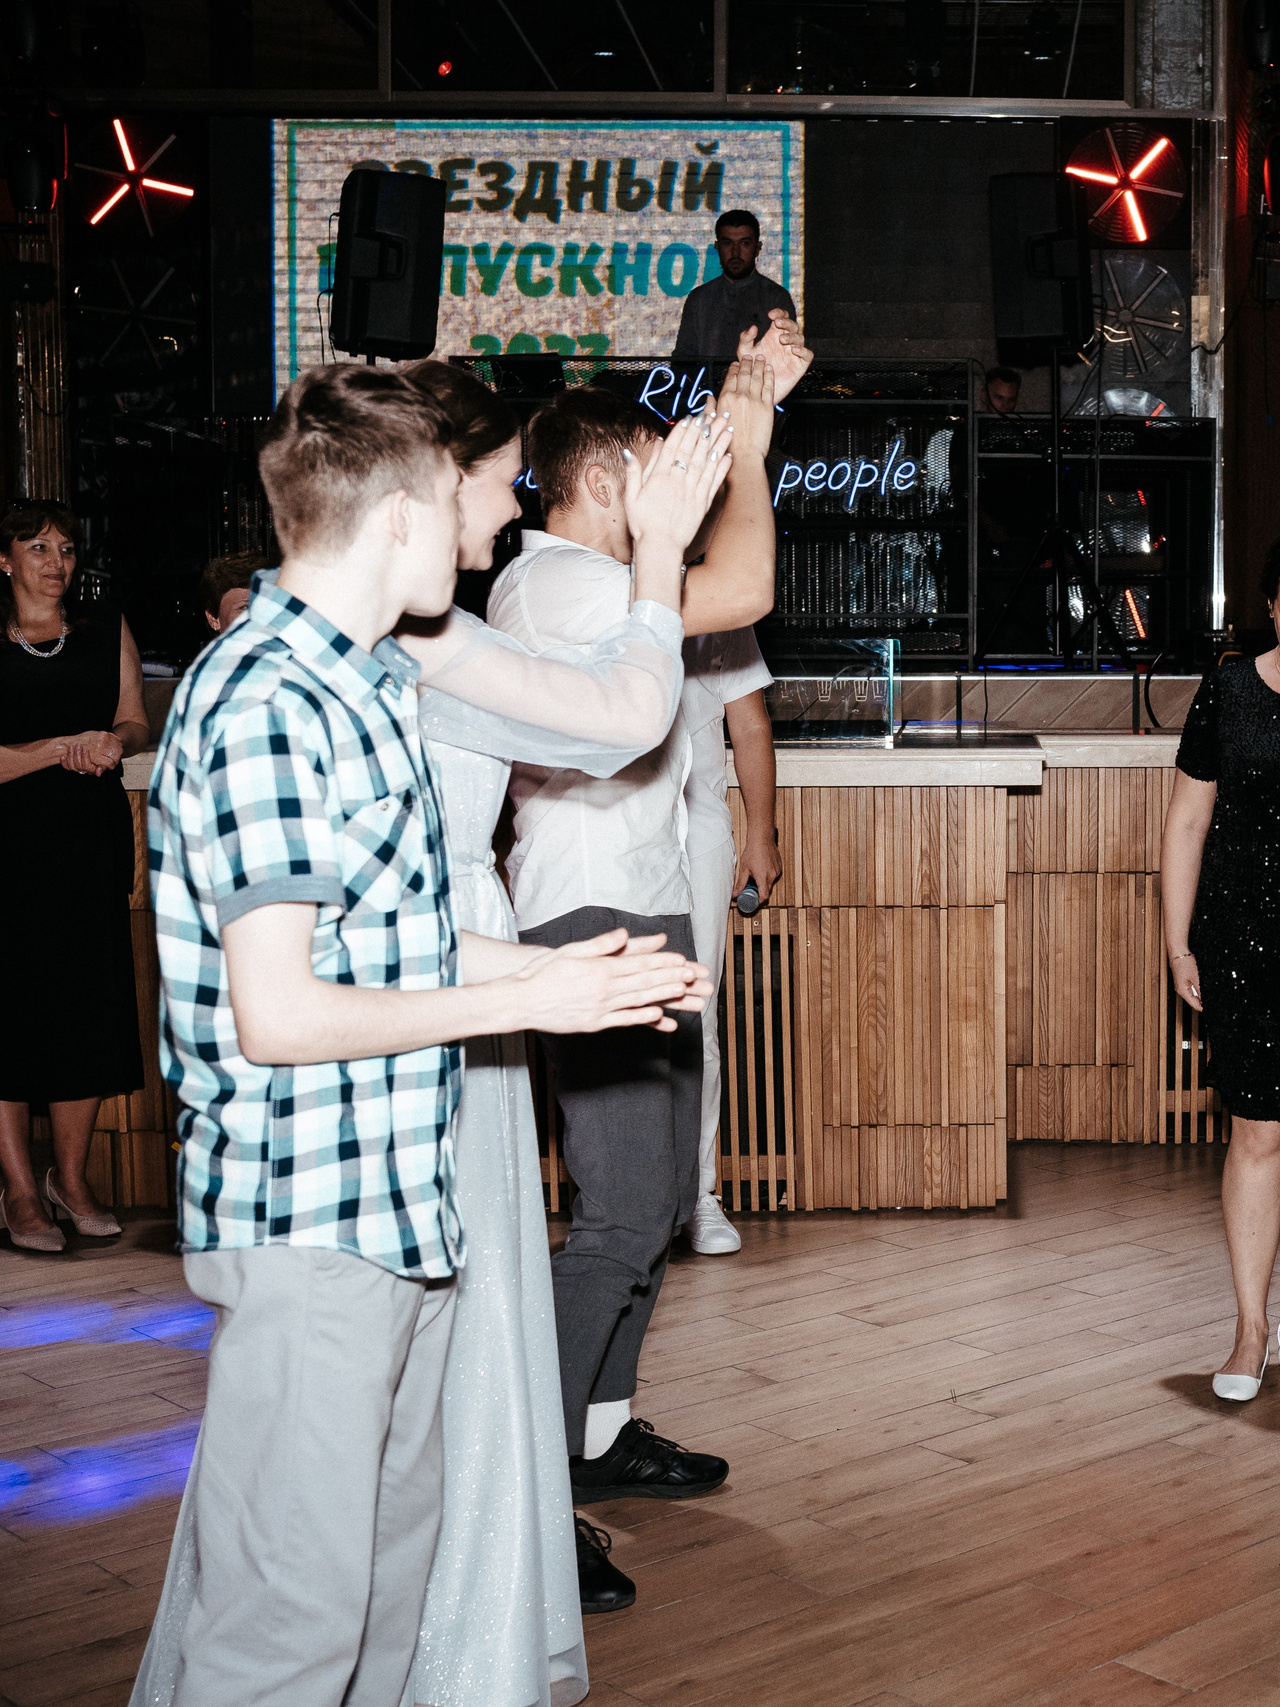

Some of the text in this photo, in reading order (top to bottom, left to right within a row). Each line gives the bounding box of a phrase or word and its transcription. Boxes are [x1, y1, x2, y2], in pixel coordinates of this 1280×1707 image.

[351, 140, 725, 224] ЕЗДНЫЙ
[317, 241, 723, 298] ПУСКНО
[772, 439, 917, 508] people
